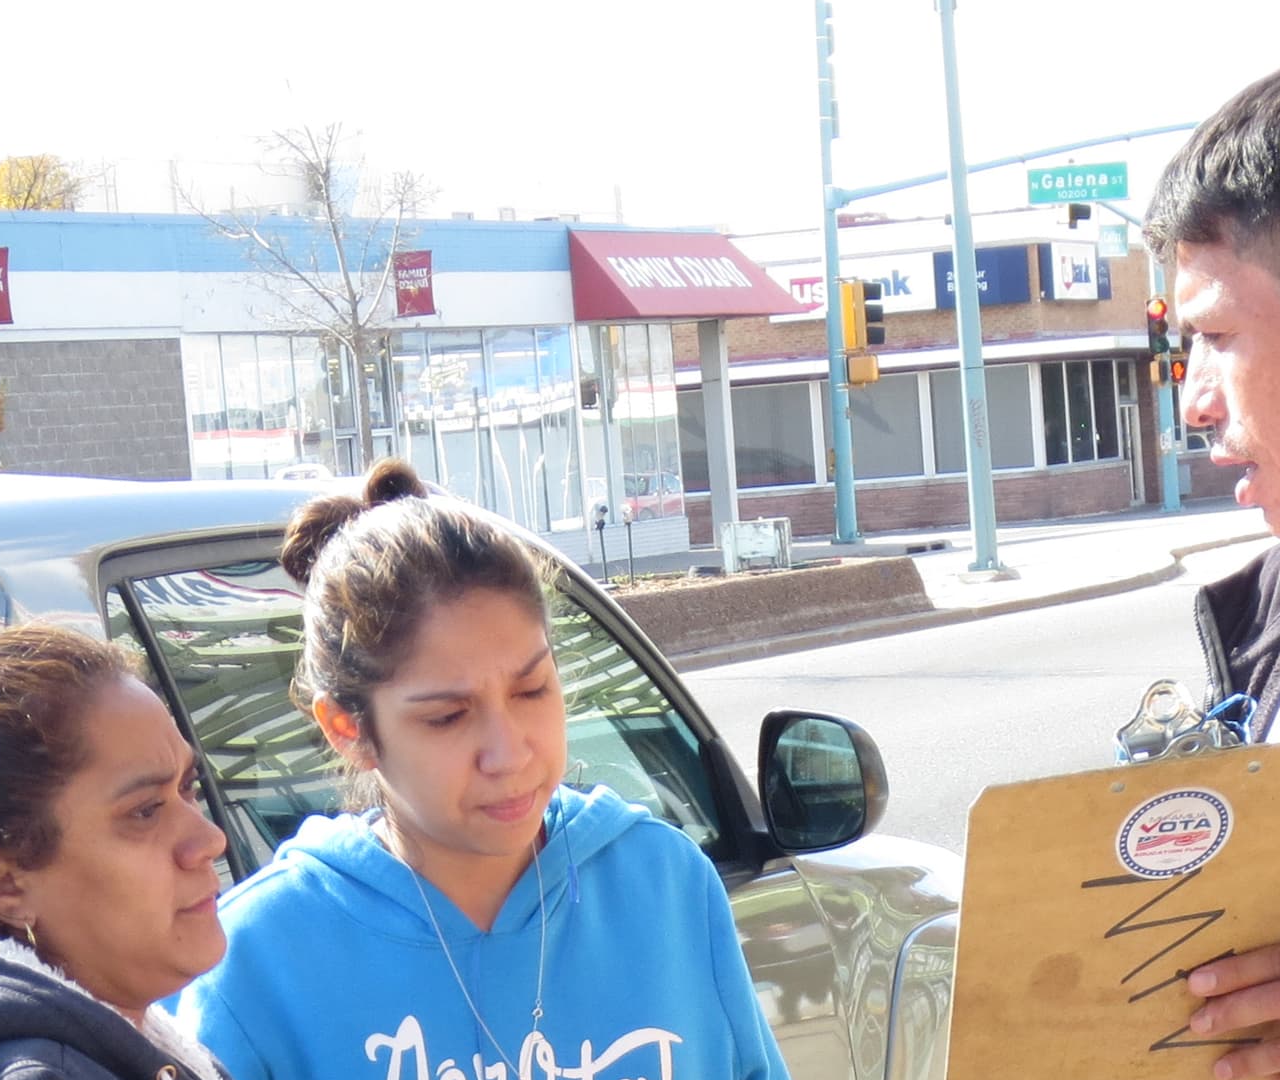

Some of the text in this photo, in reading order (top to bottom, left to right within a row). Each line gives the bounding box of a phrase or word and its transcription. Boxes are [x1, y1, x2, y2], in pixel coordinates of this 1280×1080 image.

[1041, 173, 1108, 189] Galena
[1111, 175, 1124, 185] ST
[1058, 189, 1088, 199] 10200
[607, 256, 753, 288] FAMILY DOLLAR
[1139, 818, 1212, 834] VOTA
